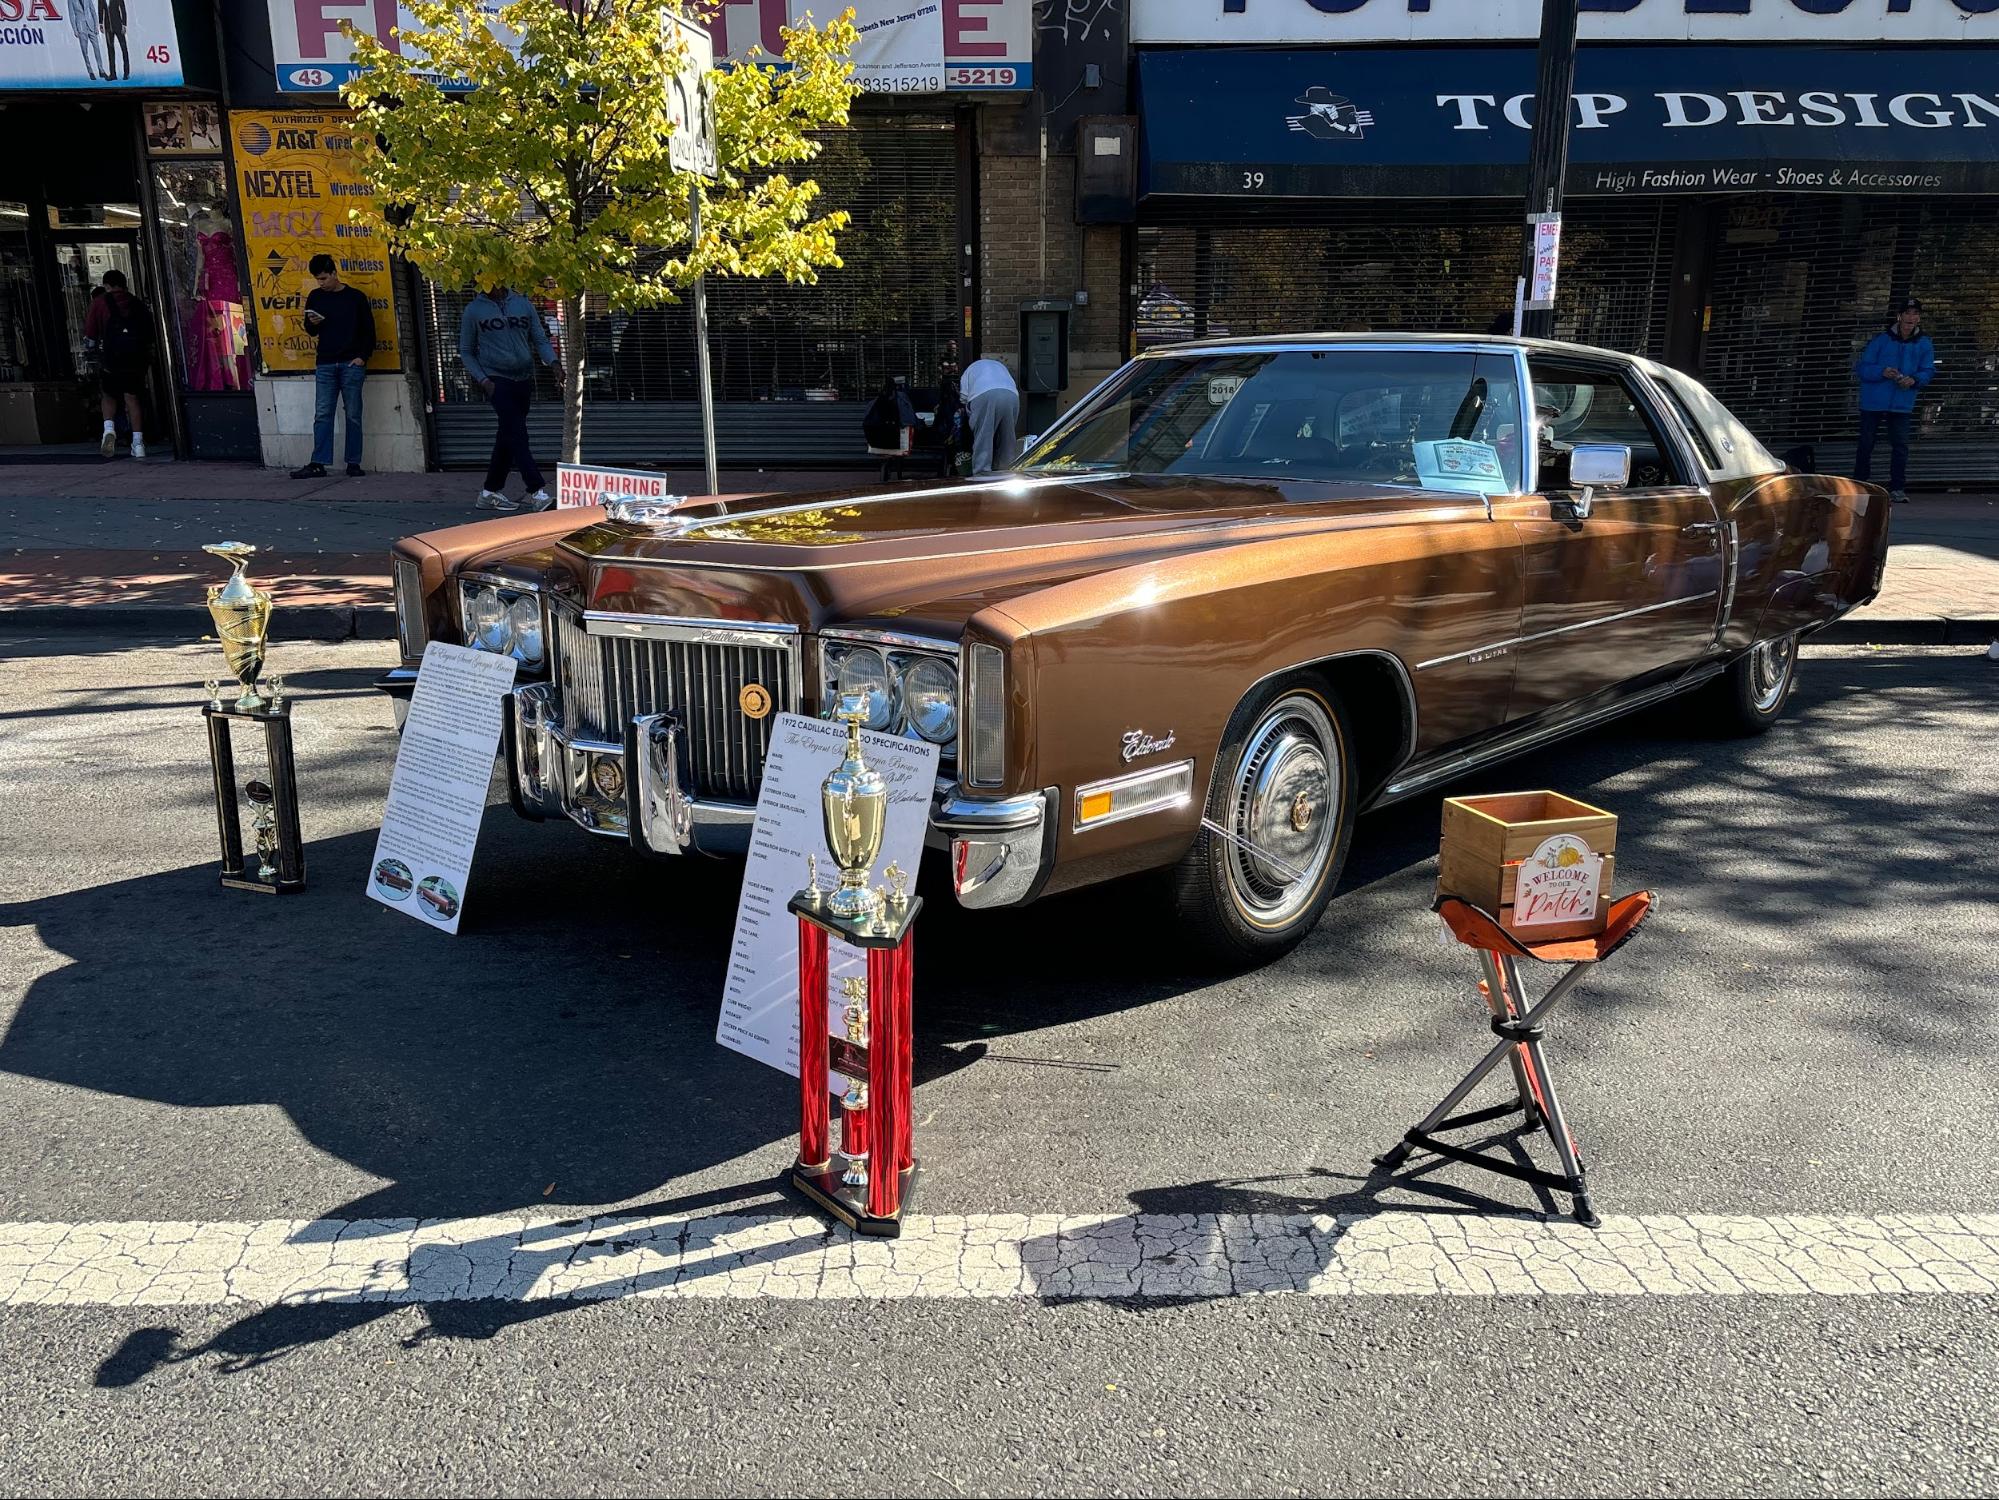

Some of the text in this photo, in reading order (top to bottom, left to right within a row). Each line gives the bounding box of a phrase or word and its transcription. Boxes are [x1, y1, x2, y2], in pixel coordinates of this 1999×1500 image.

[879, 19, 895, 28] New
[896, 12, 917, 23] Jersey
[917, 4, 938, 17] 07201
[0, 24, 44, 45] CIÓN
[146, 46, 170, 64] 45
[298, 70, 323, 85] 43
[272, 115, 359, 125] AUTHRIZED DEAL
[276, 129, 319, 150] AT&T
[244, 170, 375, 199] NEXTEL Wireless
[1242, 172, 1265, 189] 39
[1596, 171, 1636, 191] High
[1642, 169, 1705, 187] Fashion
[1712, 168, 1758, 186] Wear
[1776, 167, 1824, 187] Shoes
[1829, 169, 1843, 187] &
[1849, 169, 1942, 188] Accessories
[252, 211, 326, 238] MCI
[89, 255, 101, 265] 45
[340, 258, 385, 272] Wireless
[260, 292, 300, 310] veri
[479, 316, 530, 333] KORS
[1211, 385, 1235, 395] 2018
[561, 471, 661, 496] NOW HIRING
[561, 488, 600, 507] DRIV
[701, 630, 744, 644] Cadillac
[782, 717, 797, 728] 1972
[797, 721, 831, 735] CADILLAC
[872, 736, 931, 758] SPECIFICATIONS
[1531, 868, 1590, 886] WELCOME
[1526, 886, 1585, 922] Patch
